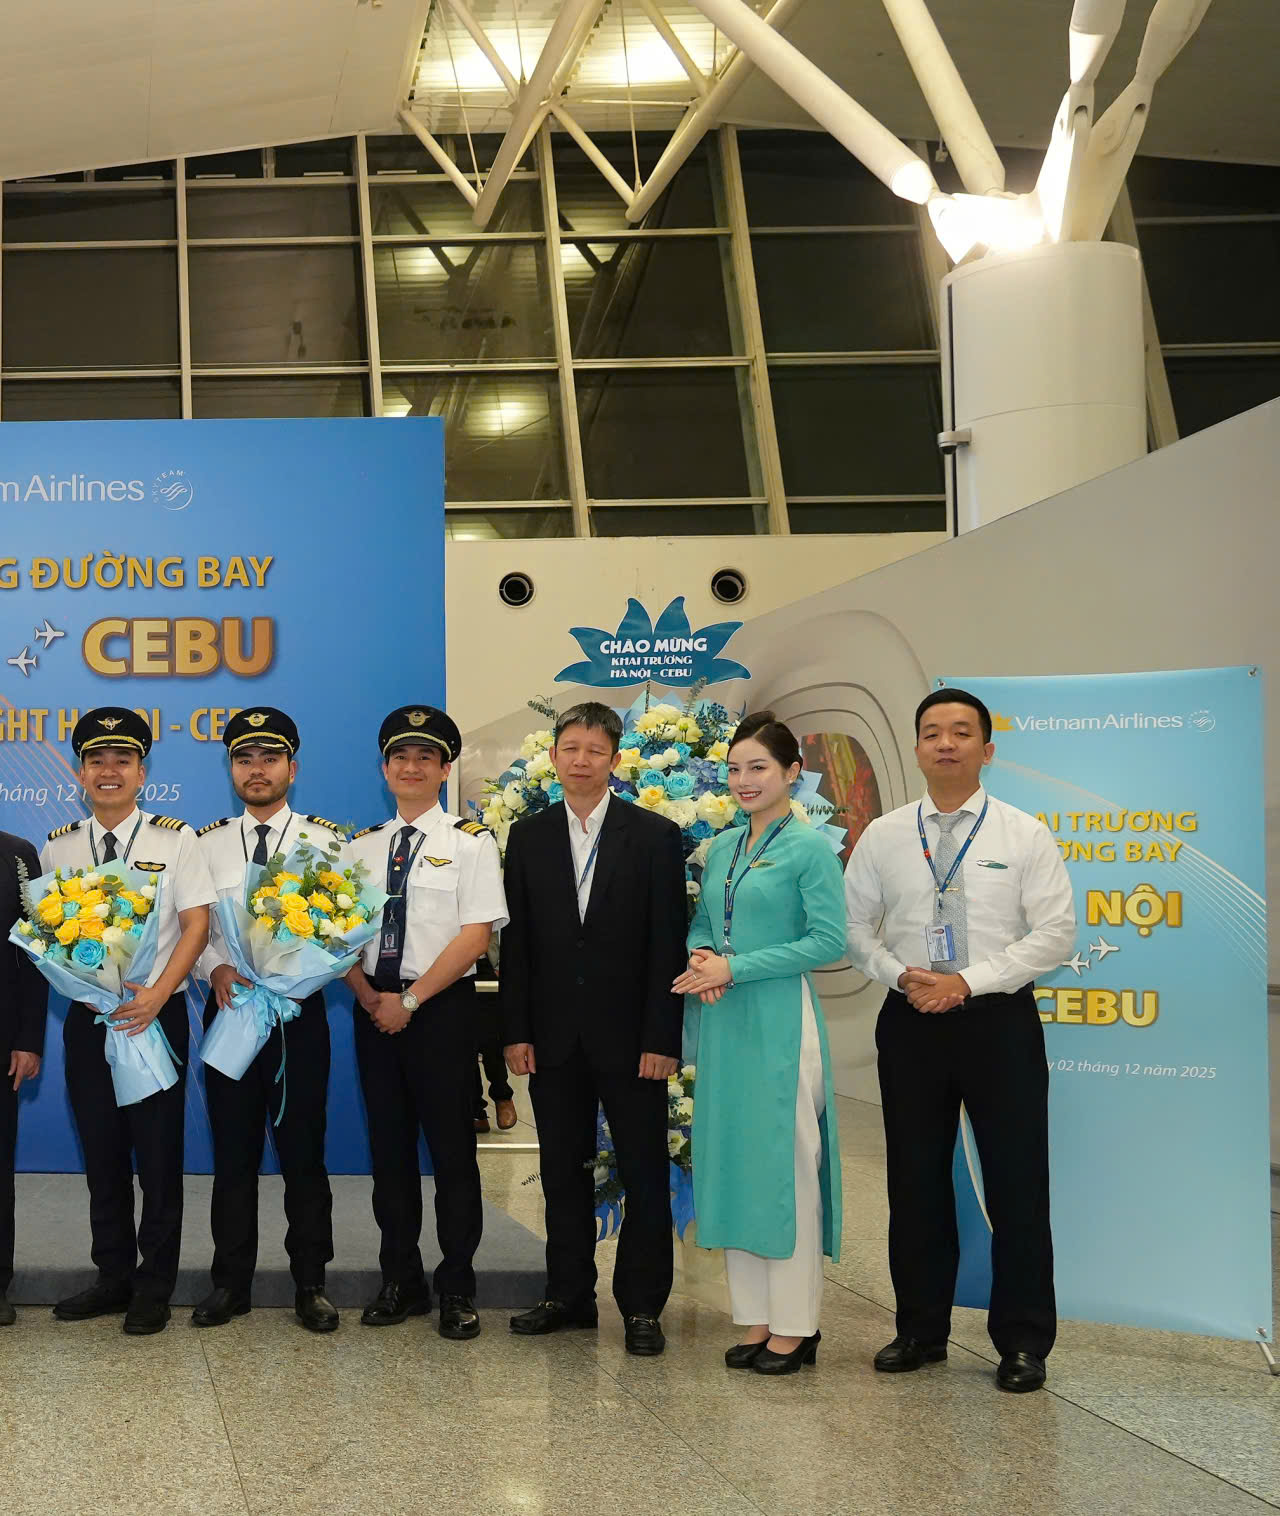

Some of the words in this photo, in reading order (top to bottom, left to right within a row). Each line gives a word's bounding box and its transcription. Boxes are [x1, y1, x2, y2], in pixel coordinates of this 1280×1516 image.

[23, 473, 145, 502] Airlines
[29, 551, 184, 588] ĐƯỜNG
[197, 556, 274, 588] BAY
[82, 616, 274, 678] CEBU
[611, 657, 640, 666] KHAI
[642, 655, 692, 665] TRƯƠNG
[610, 668, 627, 678] HÀ
[629, 668, 651, 679] NỘI
[660, 668, 692, 678] CEBU
[1015, 715, 1101, 731] Vietnam
[1102, 712, 1183, 729] Airlines
[56, 784, 76, 801] 12
[135, 784, 181, 802] 2025
[1066, 808, 1198, 832] TRƯƠNG
[1124, 841, 1183, 862] BAY
[1086, 883, 1182, 937] NỘI
[1032, 986, 1160, 1028] CEBU
[1057, 1059, 1074, 1071] 02
[1077, 1060, 1119, 1077] tháng
[1125, 1063, 1140, 1075] 12
[1144, 1064, 1177, 1077] năm
[1180, 1066, 1216, 1079] 2025
